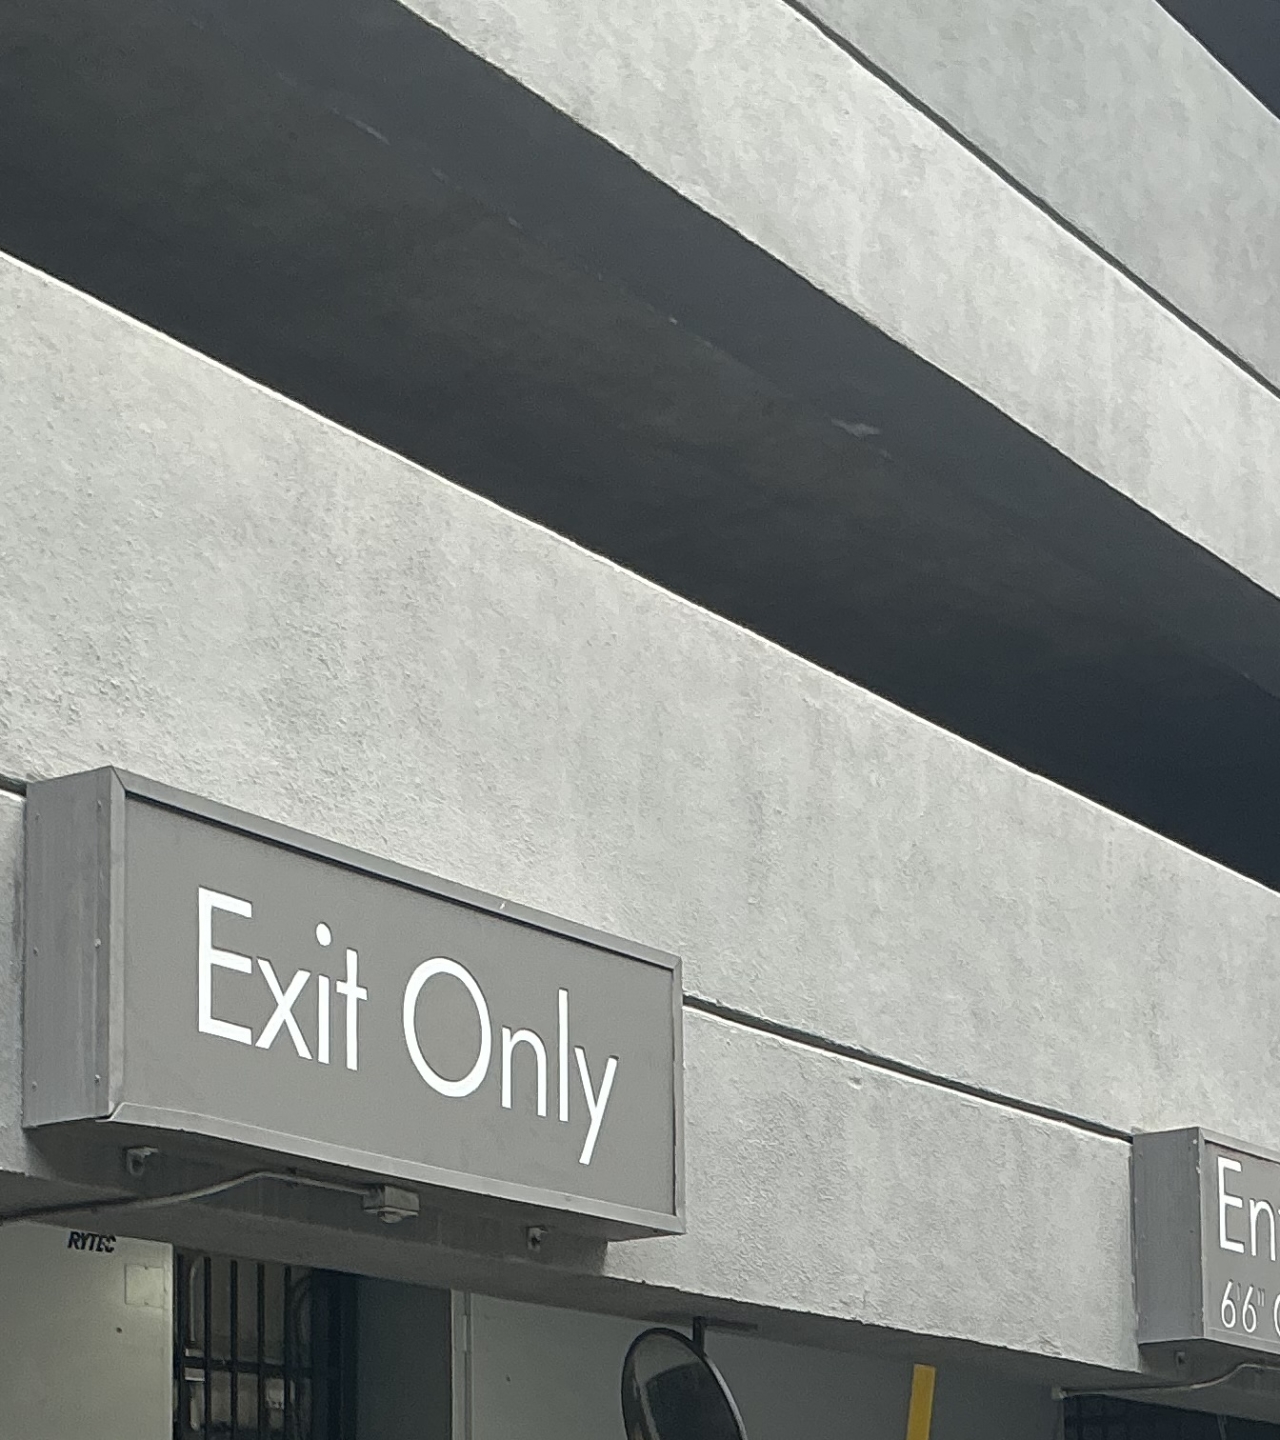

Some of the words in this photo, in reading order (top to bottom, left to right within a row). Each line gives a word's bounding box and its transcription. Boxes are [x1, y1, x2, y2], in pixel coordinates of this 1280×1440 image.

[197, 885, 368, 1072] Exit
[402, 956, 618, 1166] Only
[67, 1230, 117, 1253] RYTEC
